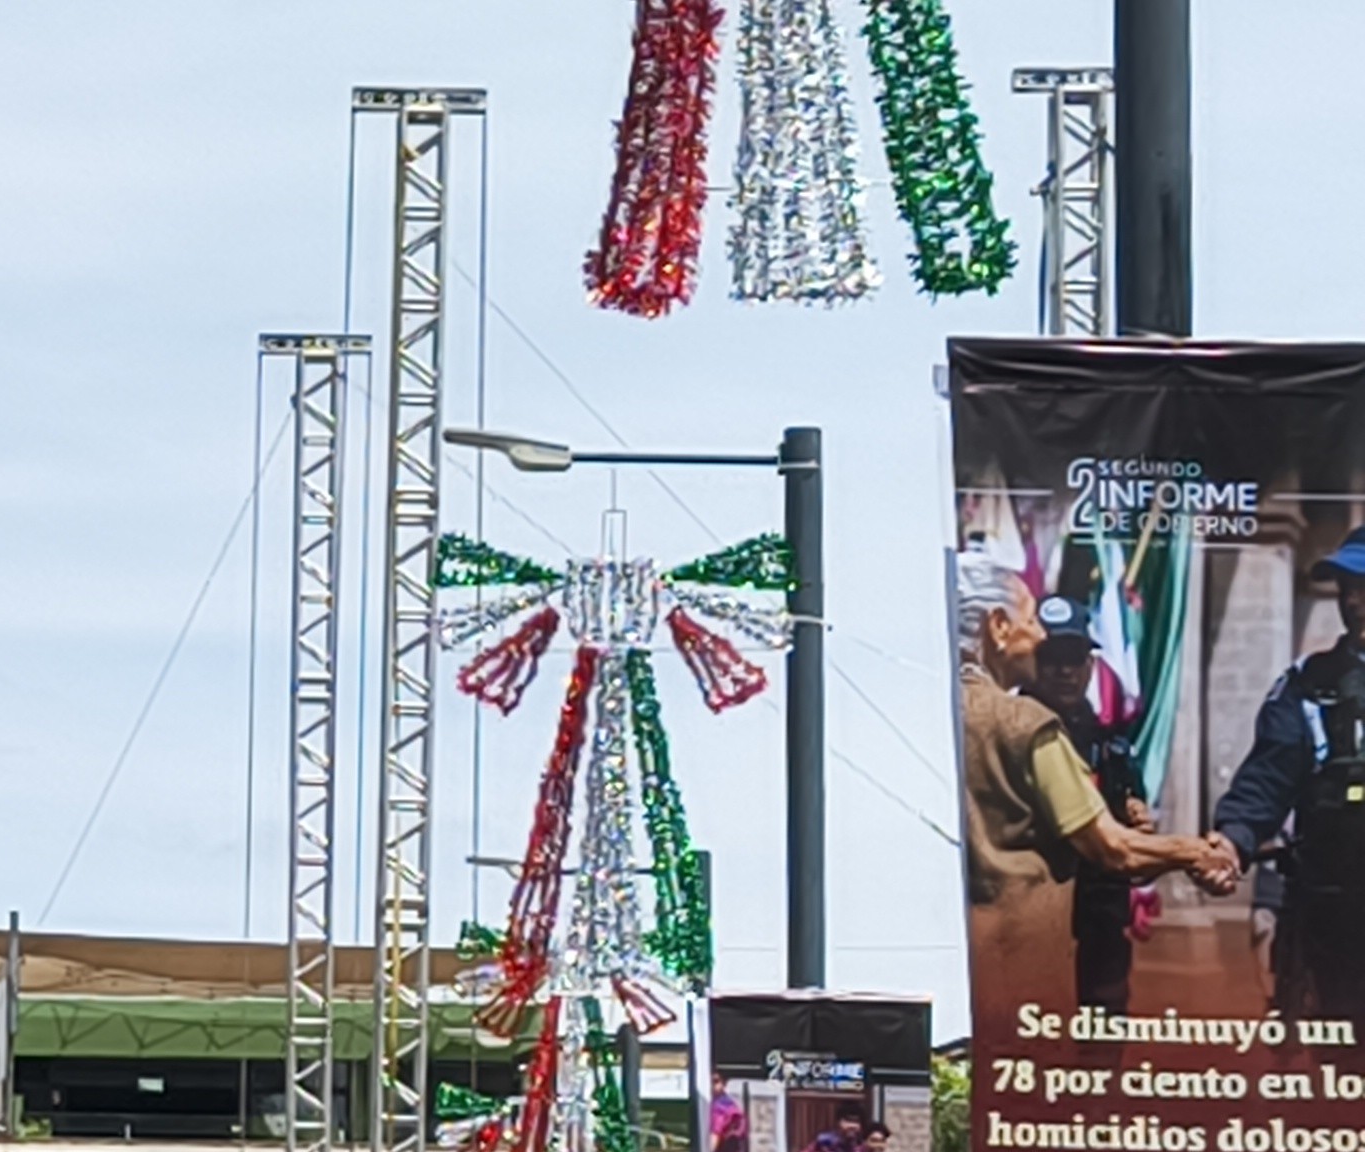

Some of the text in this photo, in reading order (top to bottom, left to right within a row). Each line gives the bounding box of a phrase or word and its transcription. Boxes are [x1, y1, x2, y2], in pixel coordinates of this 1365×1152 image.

[1097, 459, 1202, 478] SEGUNDO
[1067, 457, 1095, 532] 2
[1099, 479, 1258, 512] INFORME
[1100, 511, 1132, 532] DE
[1017, 1004, 1356, 1053] Se disminuyó un
[992, 1059, 1365, 1103] 78 por ciento en lo
[987, 1111, 1207, 1152] homicidios
